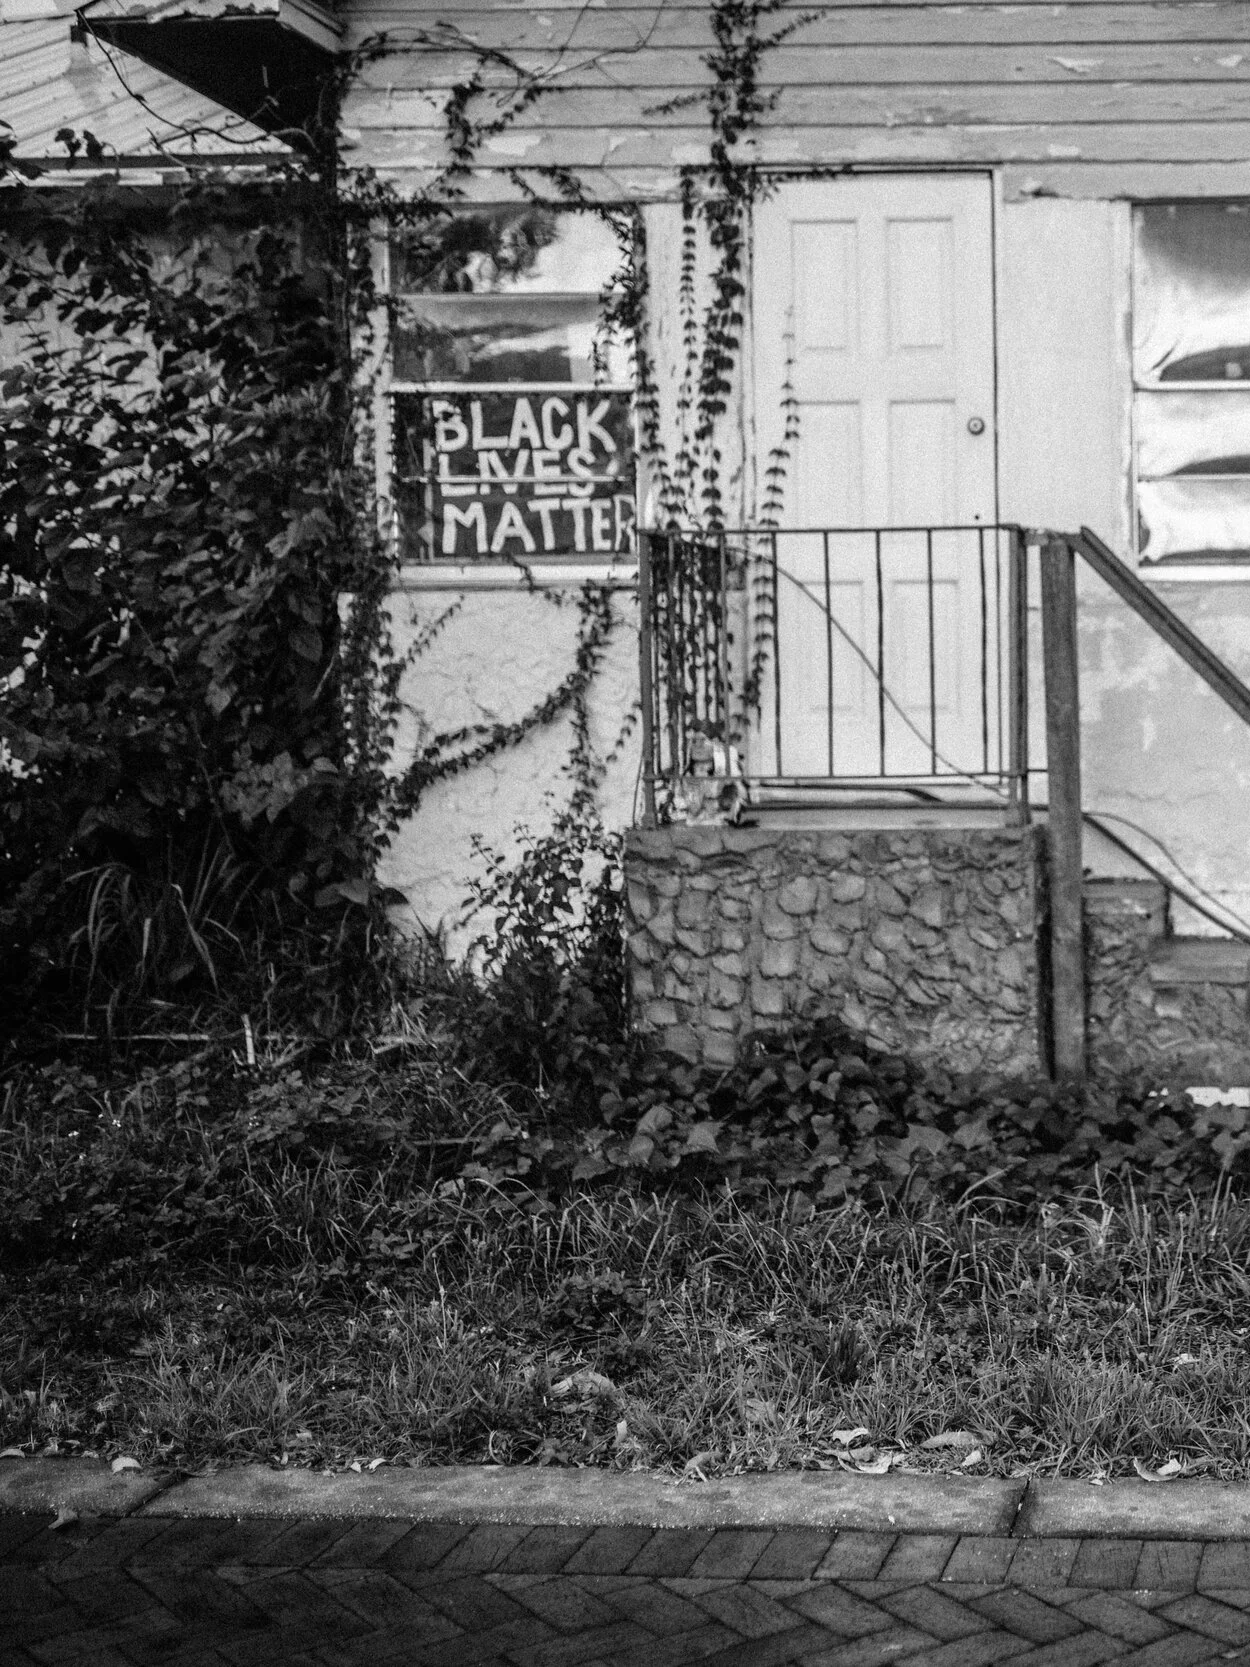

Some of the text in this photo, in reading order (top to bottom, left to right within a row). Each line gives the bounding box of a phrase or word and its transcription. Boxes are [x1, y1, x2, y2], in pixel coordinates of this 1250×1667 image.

[432, 397, 617, 452] BLACK
[438, 447, 597, 497] LIVES
[442, 495, 637, 554] MATTER
